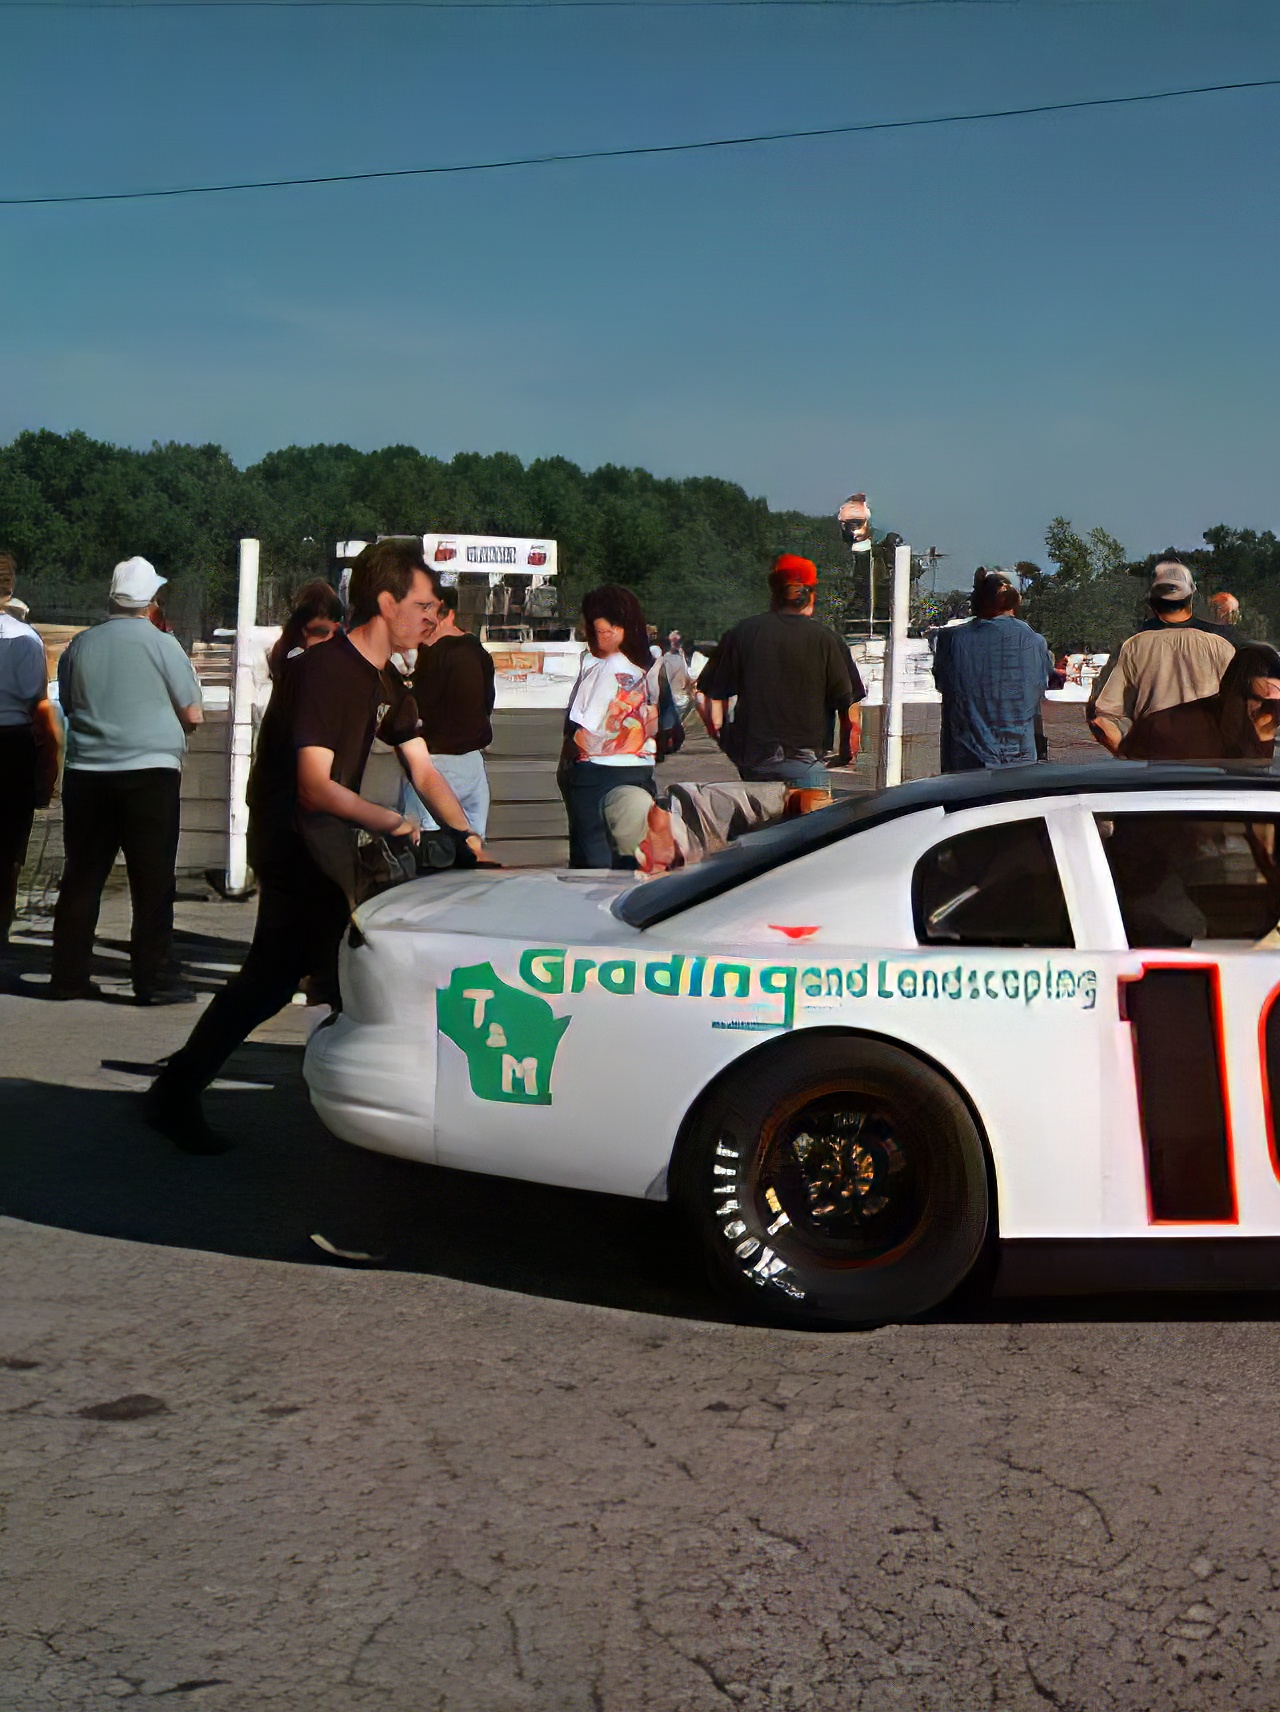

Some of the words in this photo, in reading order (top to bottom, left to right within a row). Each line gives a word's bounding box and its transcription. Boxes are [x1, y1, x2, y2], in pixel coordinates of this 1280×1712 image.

[462, 988, 495, 1029] T
[519, 948, 797, 1030] Grading
[801, 962, 868, 998] and
[877, 960, 1097, 1010] Landscaping
[501, 1053, 539, 1096] M
